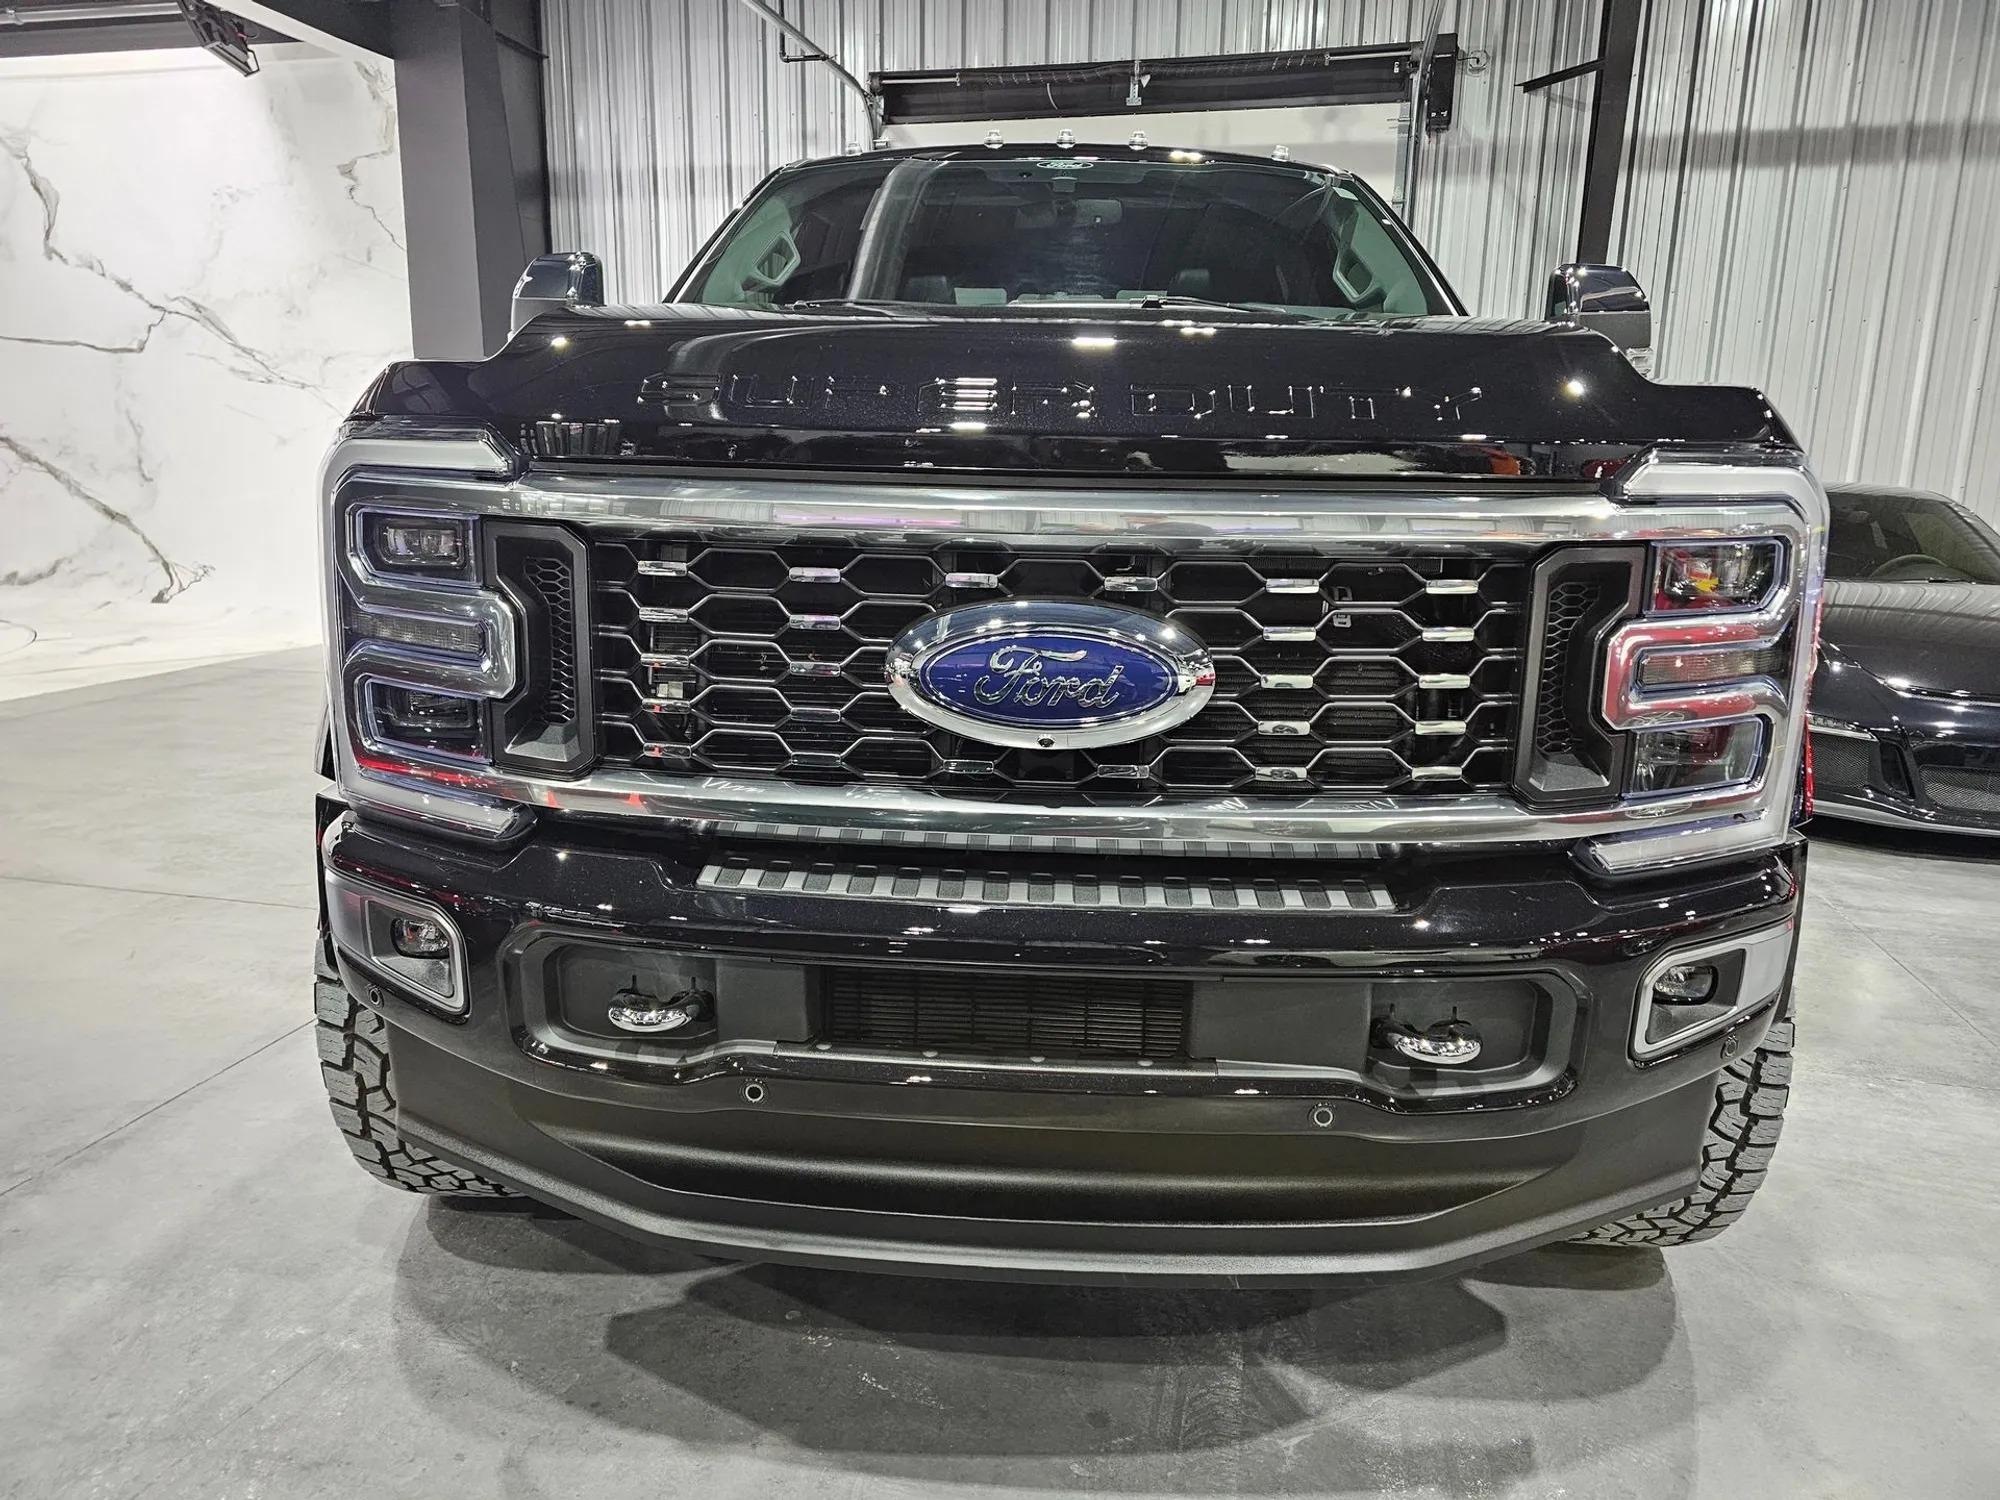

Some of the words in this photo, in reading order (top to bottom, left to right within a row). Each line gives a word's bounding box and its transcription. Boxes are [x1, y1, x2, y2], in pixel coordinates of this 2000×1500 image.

[637, 372, 1098, 416] SUPER
[1129, 384, 1483, 420] DUTY
[974, 645, 1124, 707] Ford
